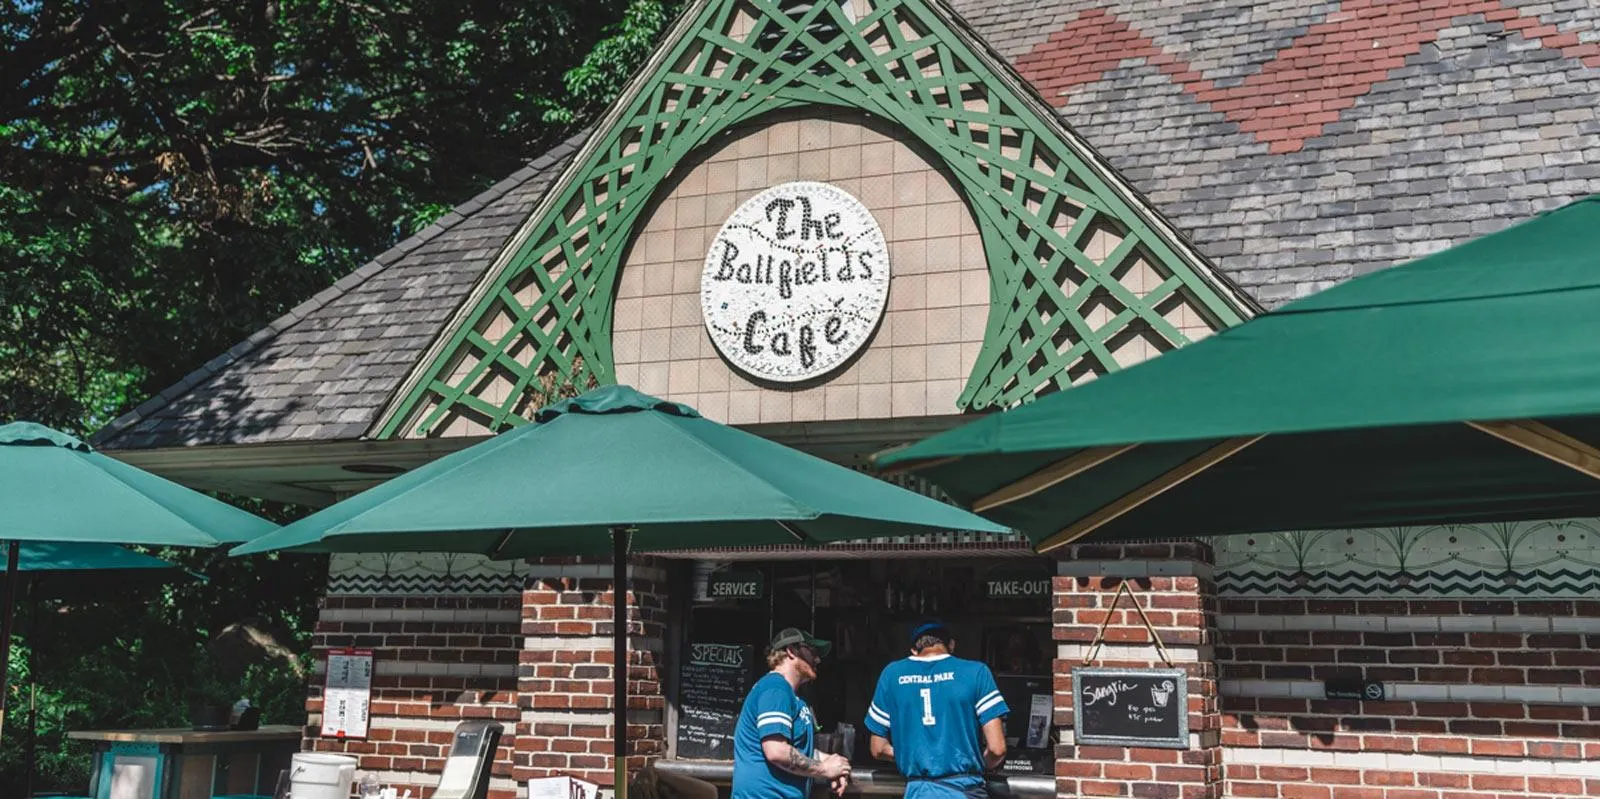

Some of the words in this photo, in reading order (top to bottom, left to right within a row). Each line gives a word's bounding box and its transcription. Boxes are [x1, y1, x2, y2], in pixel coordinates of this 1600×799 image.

[765, 196, 844, 241] The
[713, 238, 874, 300] Ballfields
[743, 297, 849, 369] Café
[712, 582, 757, 596] SERVICE
[987, 580, 1050, 595] TAKE-OUT
[691, 644, 743, 665] SPECIALS
[898, 674, 933, 685] CENTRAL
[933, 672, 955, 682] PARK
[1083, 680, 1138, 706] Sangria
[920, 688, 937, 726] 1
